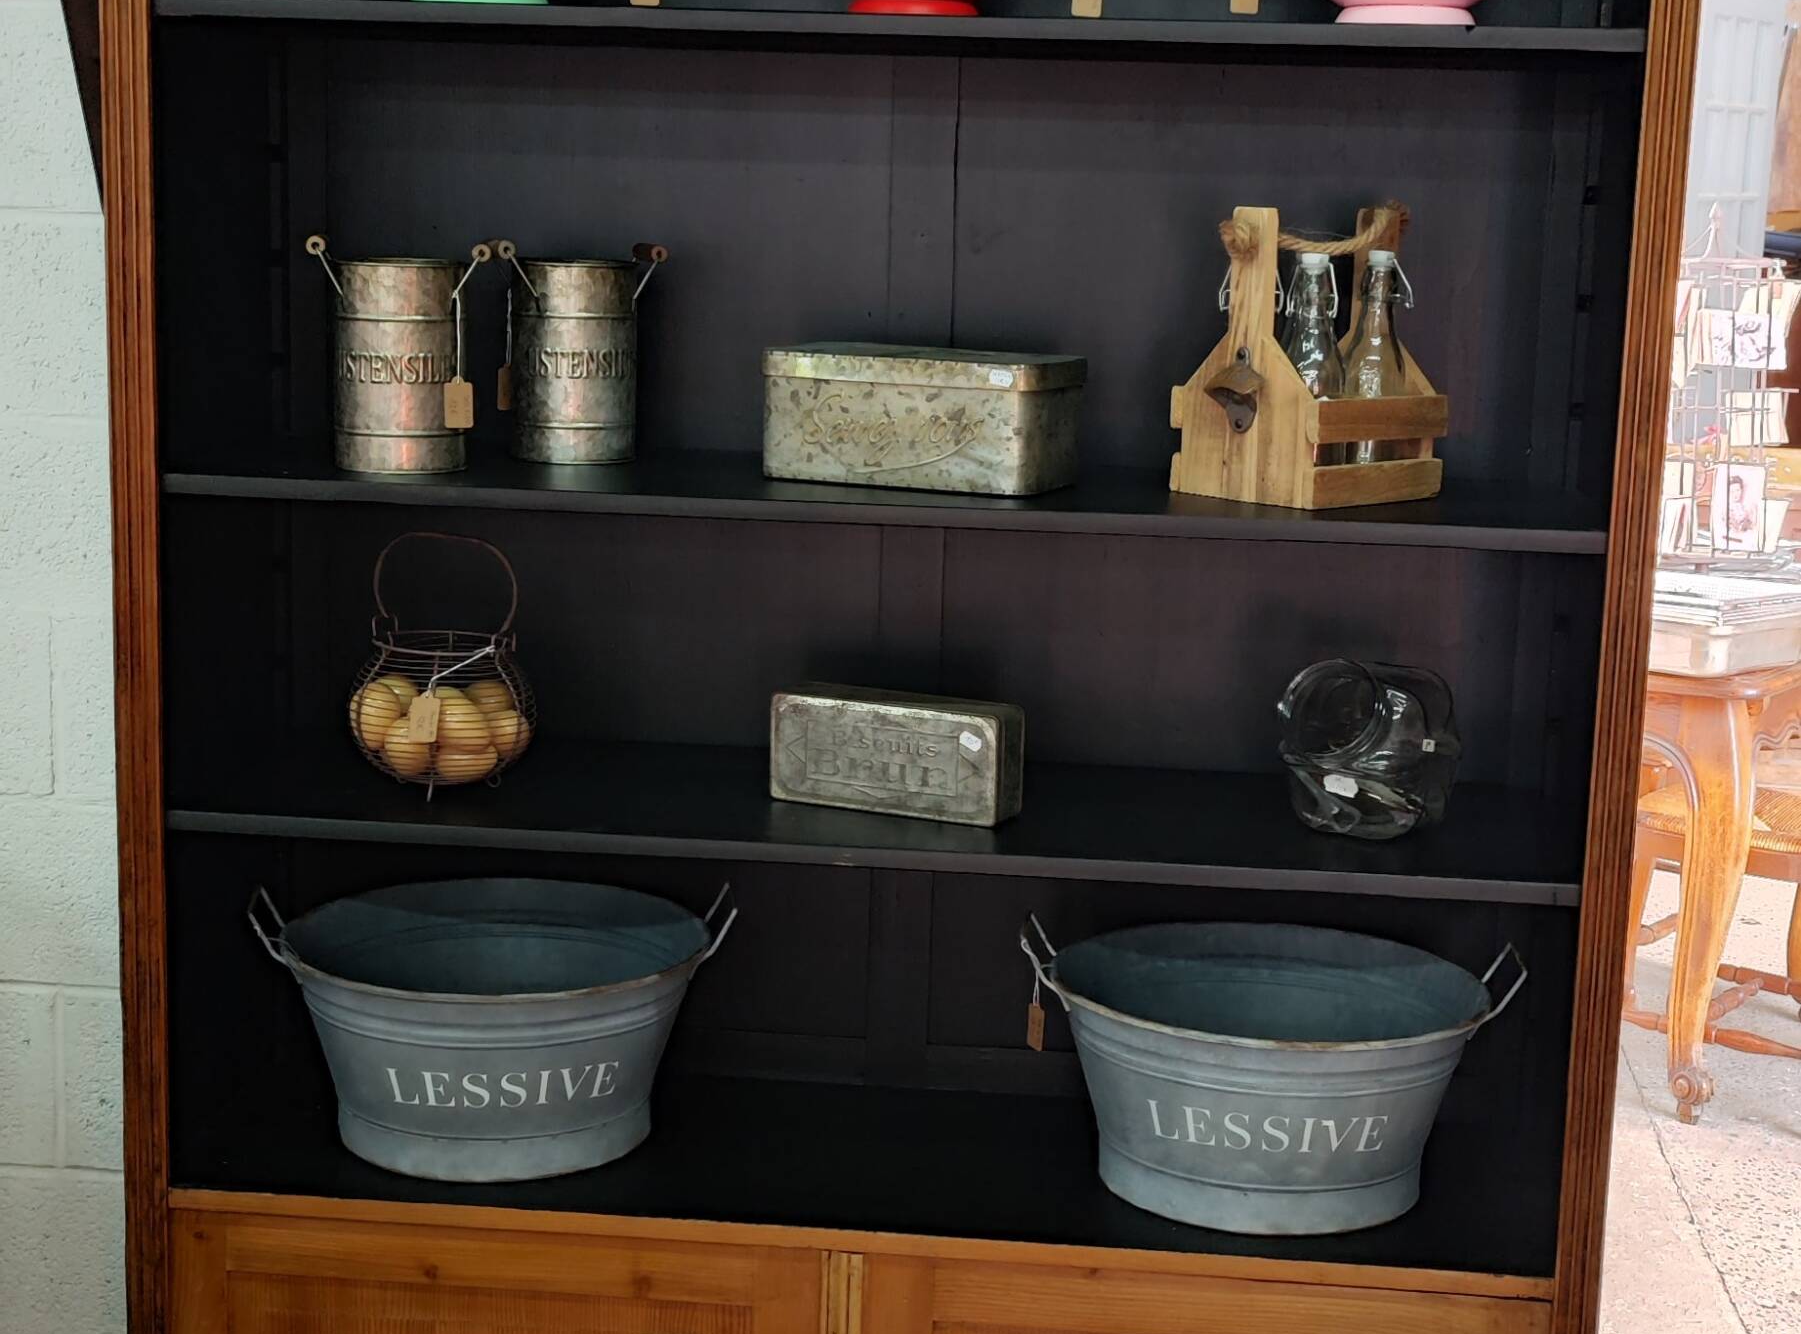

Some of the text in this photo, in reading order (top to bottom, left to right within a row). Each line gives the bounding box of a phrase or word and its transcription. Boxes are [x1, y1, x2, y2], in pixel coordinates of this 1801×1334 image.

[808, 747, 948, 789] Brun
[386, 1061, 619, 1109] LESSIVE
[1147, 1099, 1388, 1153] LESSIVE
